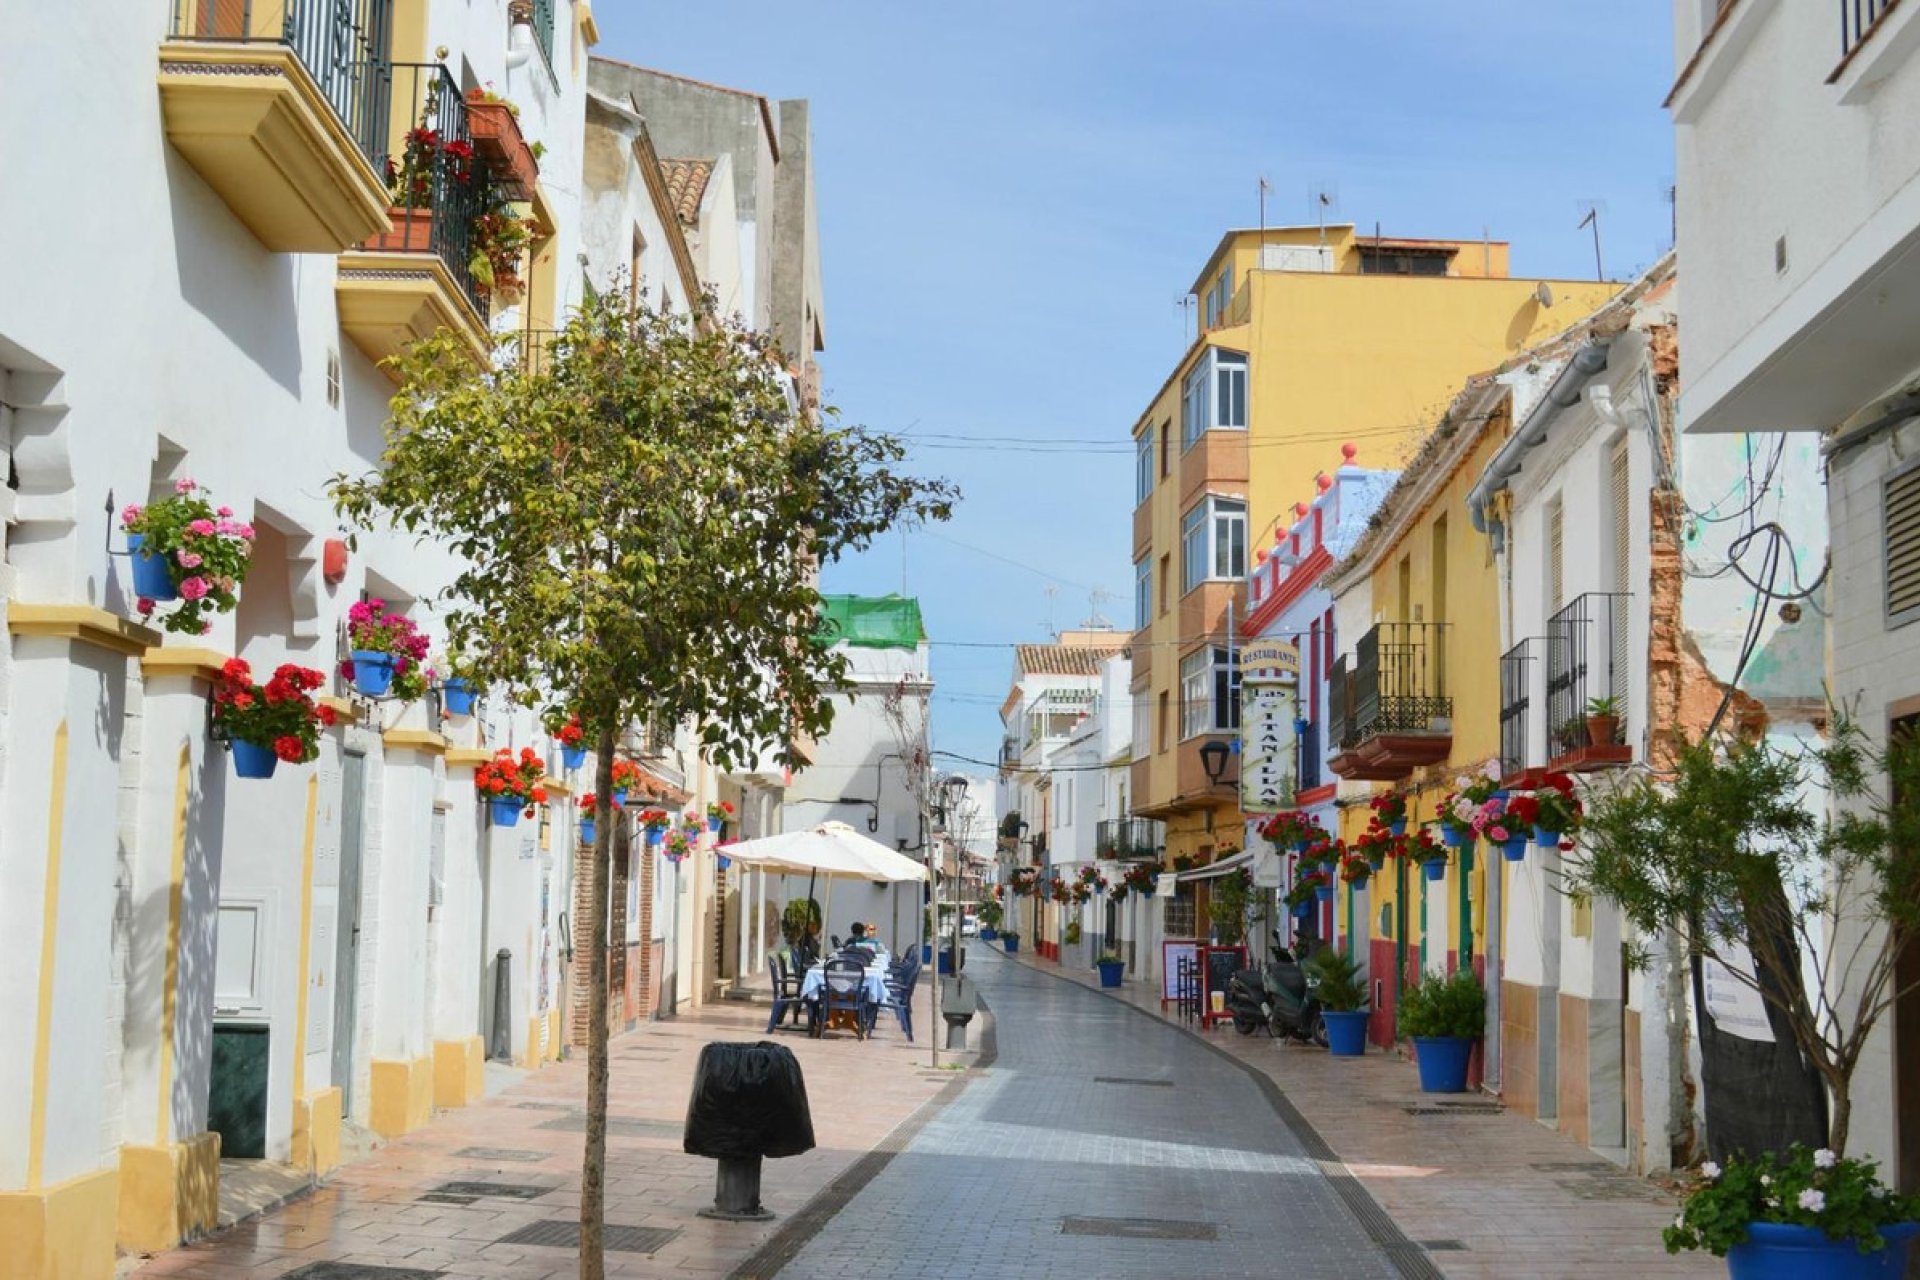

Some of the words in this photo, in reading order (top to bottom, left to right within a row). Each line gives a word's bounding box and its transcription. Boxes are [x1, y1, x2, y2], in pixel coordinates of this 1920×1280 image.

[1243, 649, 1297, 665] RESTAURANTE
[1254, 688, 1285, 697] Las
[1261, 701, 1278, 806] GITANILLAS
